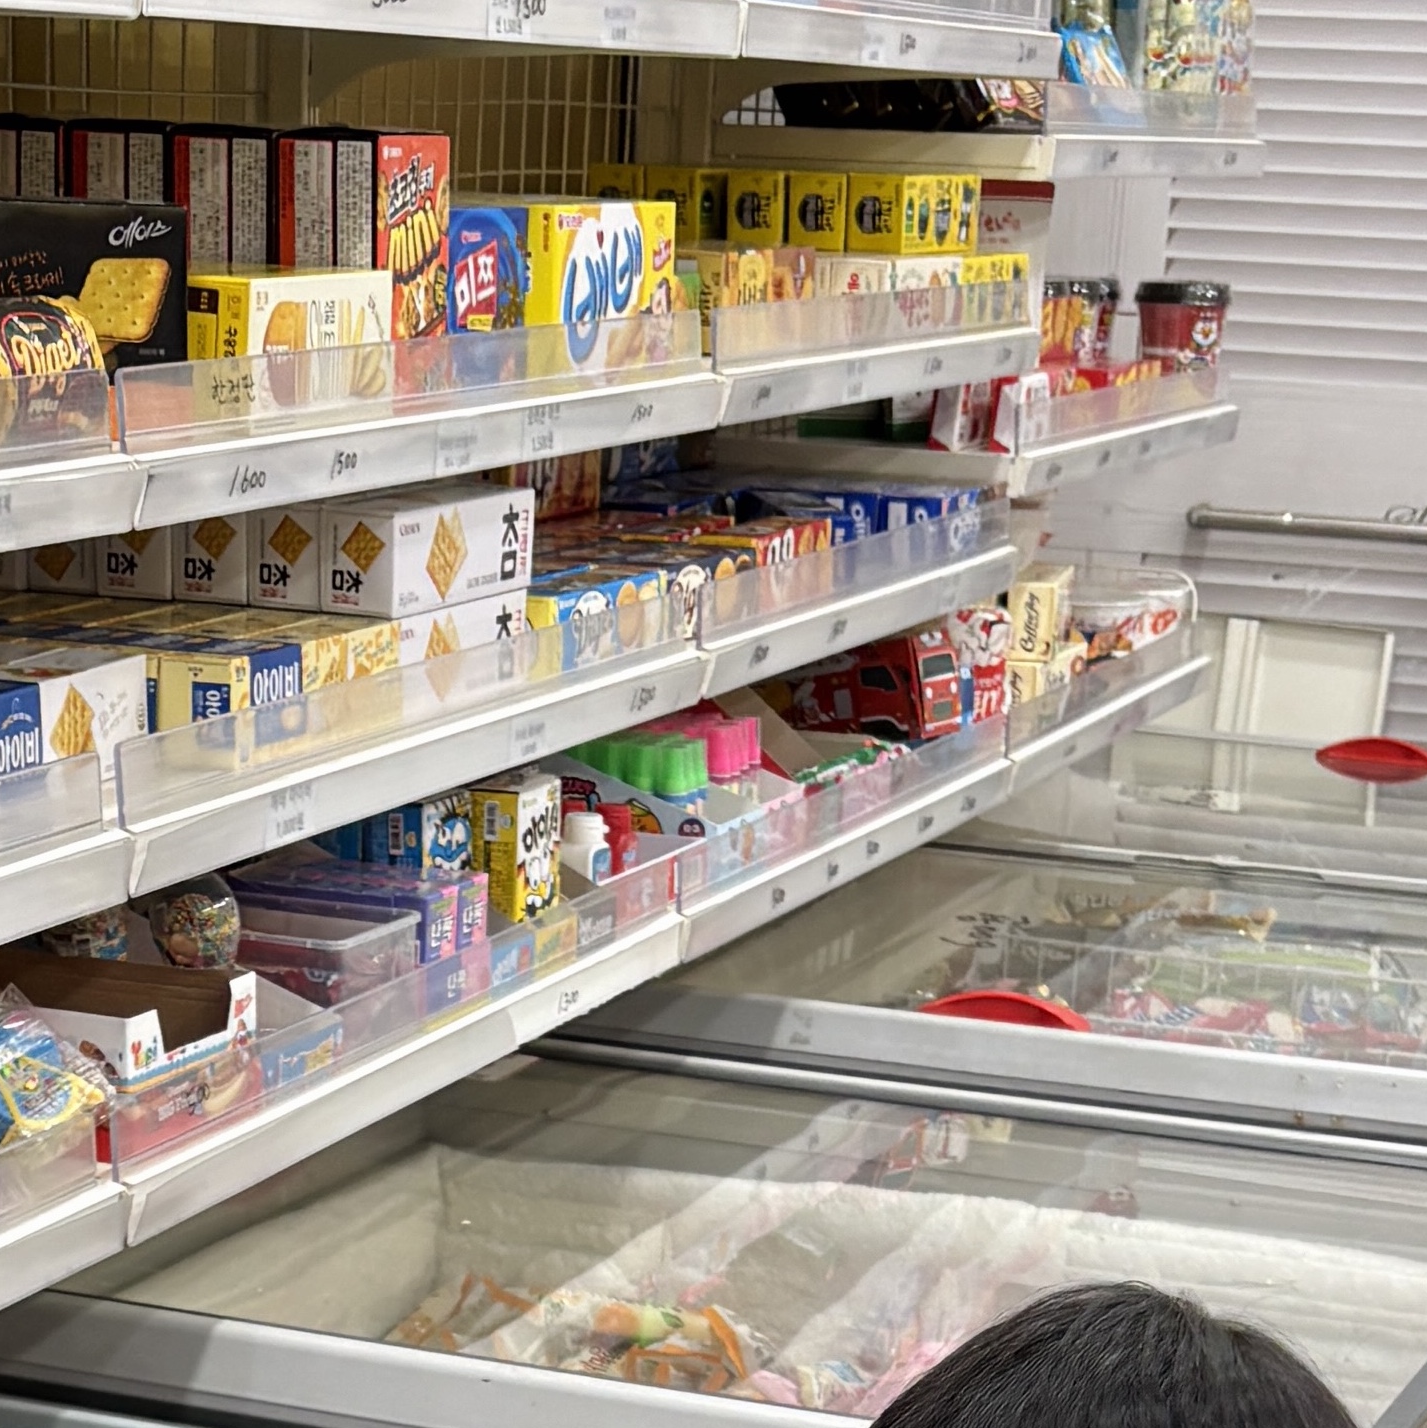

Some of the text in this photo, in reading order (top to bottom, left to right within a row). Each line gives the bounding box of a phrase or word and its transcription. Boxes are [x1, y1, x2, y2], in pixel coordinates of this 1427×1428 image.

[107, 215, 173, 249] 에이스
[387, 197, 440, 278] mini
[455, 252, 496, 315] 미쯔
